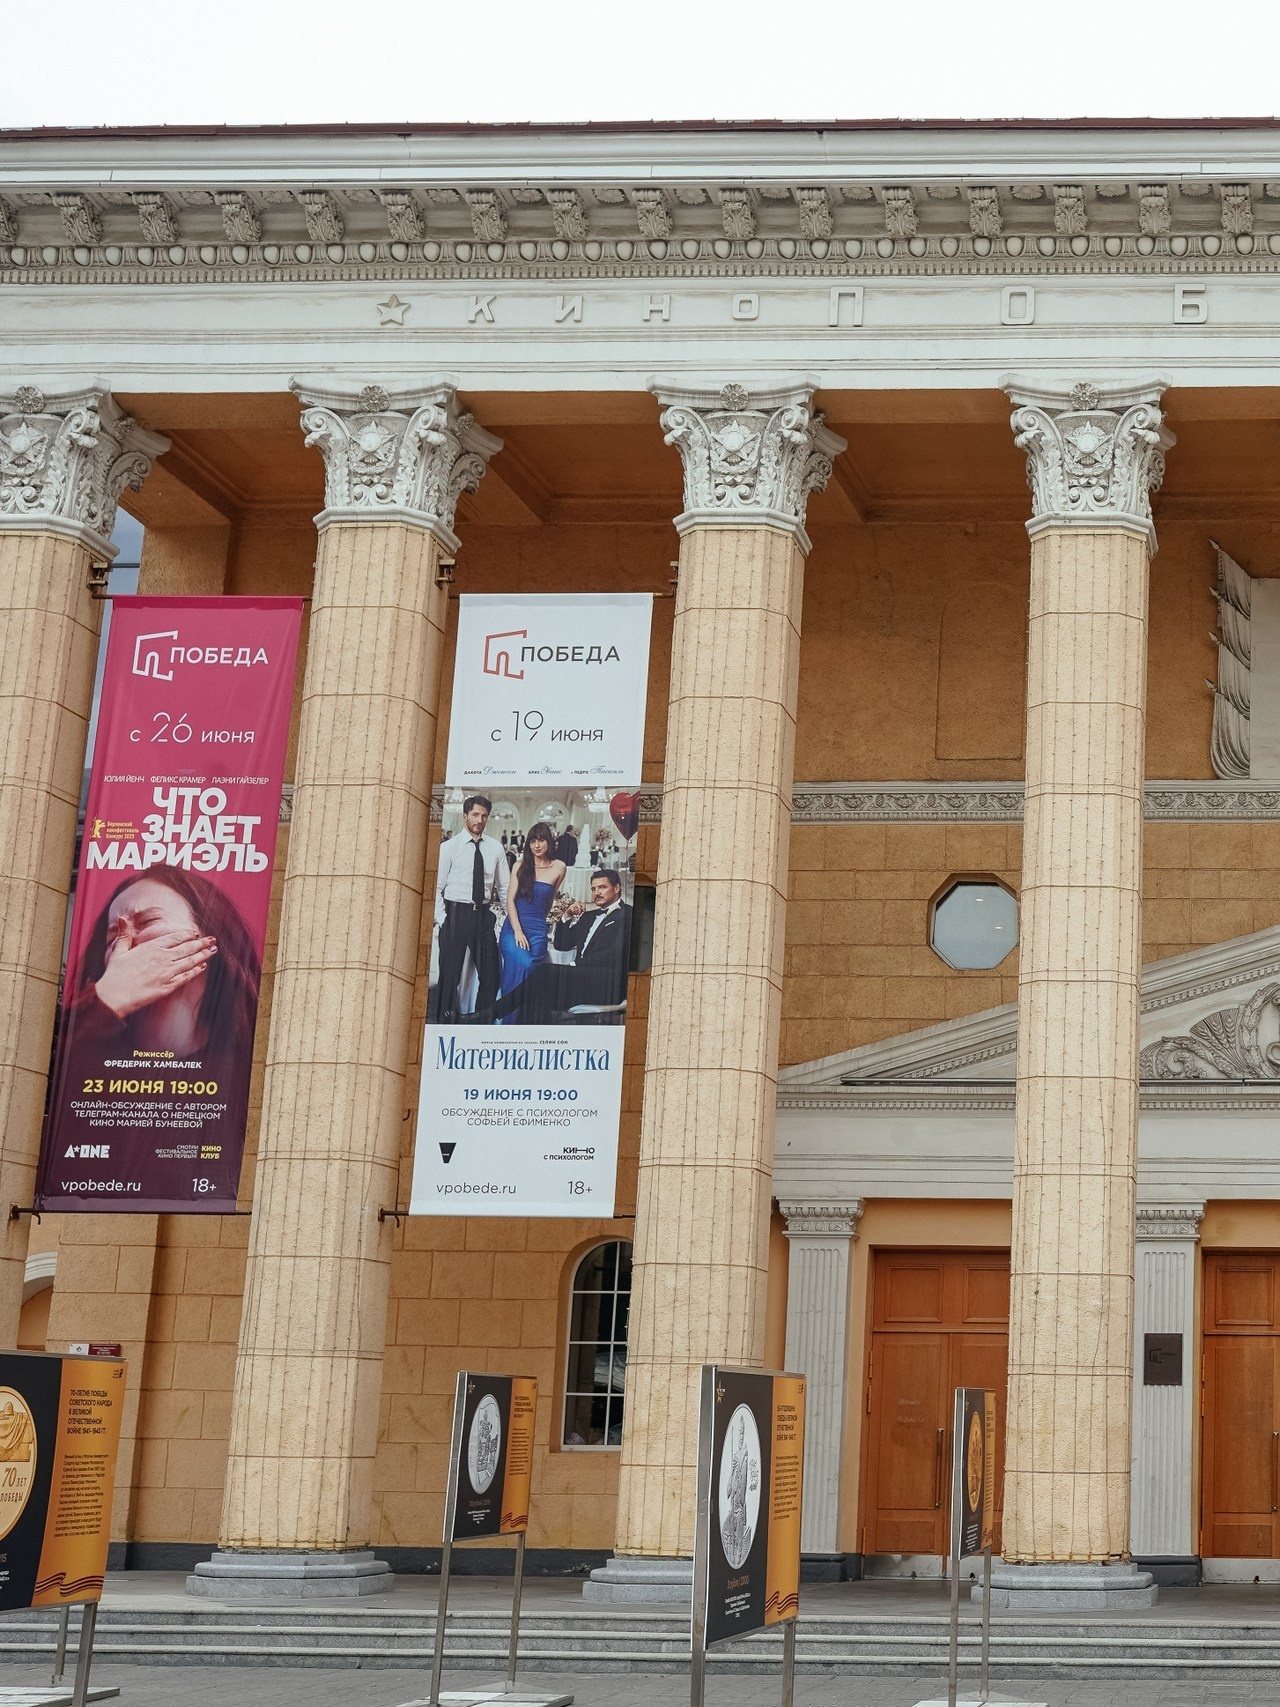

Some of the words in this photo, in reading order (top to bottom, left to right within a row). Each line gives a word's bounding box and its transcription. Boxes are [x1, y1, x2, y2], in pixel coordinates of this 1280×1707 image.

[467, 293, 760, 323] КИНО
[169, 646, 269, 668] ПОБЕДА
[520, 645, 621, 665] ПОБЕДА
[150, 712, 193, 744] 26
[512, 710, 544, 741] 19
[104, 775, 125, 783] ЮЛИЯ
[150, 775, 178, 784] ФЕЛИКС
[179, 776, 206, 784] КРАМЕР
[212, 776, 236, 784] ЛАЭНИ
[152, 787, 228, 816] ЧТО
[141, 814, 262, 844] ЗНАЕТ
[85, 841, 269, 873] МАРИЭЛЬ
[132, 1050, 174, 1059] Режиссёр
[436, 1036, 610, 1071] Материалистка
[104, 1060, 151, 1069] ФРЕДЕРИК
[153, 1060, 202, 1069] ХАМБАЛЕК
[82, 1079, 104, 1093] 23
[109, 1079, 164, 1094] ИЮНЯ
[170, 1080, 218, 1095] 19:00
[464, 1089, 479, 1100] 19
[484, 1089, 531, 1101] ИЮНЯ
[536, 1089, 578, 1101] 19:00
[70, 1100, 173, 1110] ОНЛАЙН-ОБСУЖДЕНИЕ
[183, 1103, 227, 1111] АВТОРОМ
[441, 1108, 514, 1117] ОБСУЖДЕНИЕ
[516, 1108, 523, 1117] С
[526, 1108, 598, 1118] ПСИХОЛОГОМ
[75, 1109, 160, 1119] ТЕЛЕГРАМ-КАНАЛА
[161, 1111, 169, 1119] О
[170, 1111, 221, 1120] НЕМЕЦКОМ
[467, 1116, 510, 1127] СОФЬЕЙ
[513, 1118, 571, 1127] ЕФИМЕНКО
[89, 1119, 115, 1127] КИНО
[116, 1118, 153, 1127] МАРИЕЙ
[155, 1118, 203, 1128] БУНЕЕВОЙ
[61, 1179, 141, 1194] vpobede.ru
[192, 1178, 217, 1193] 18+
[436, 1182, 517, 1196] vpobede.ru
[568, 1180, 593, 1195] 18+
[2, 1467, 17, 1488] 70
